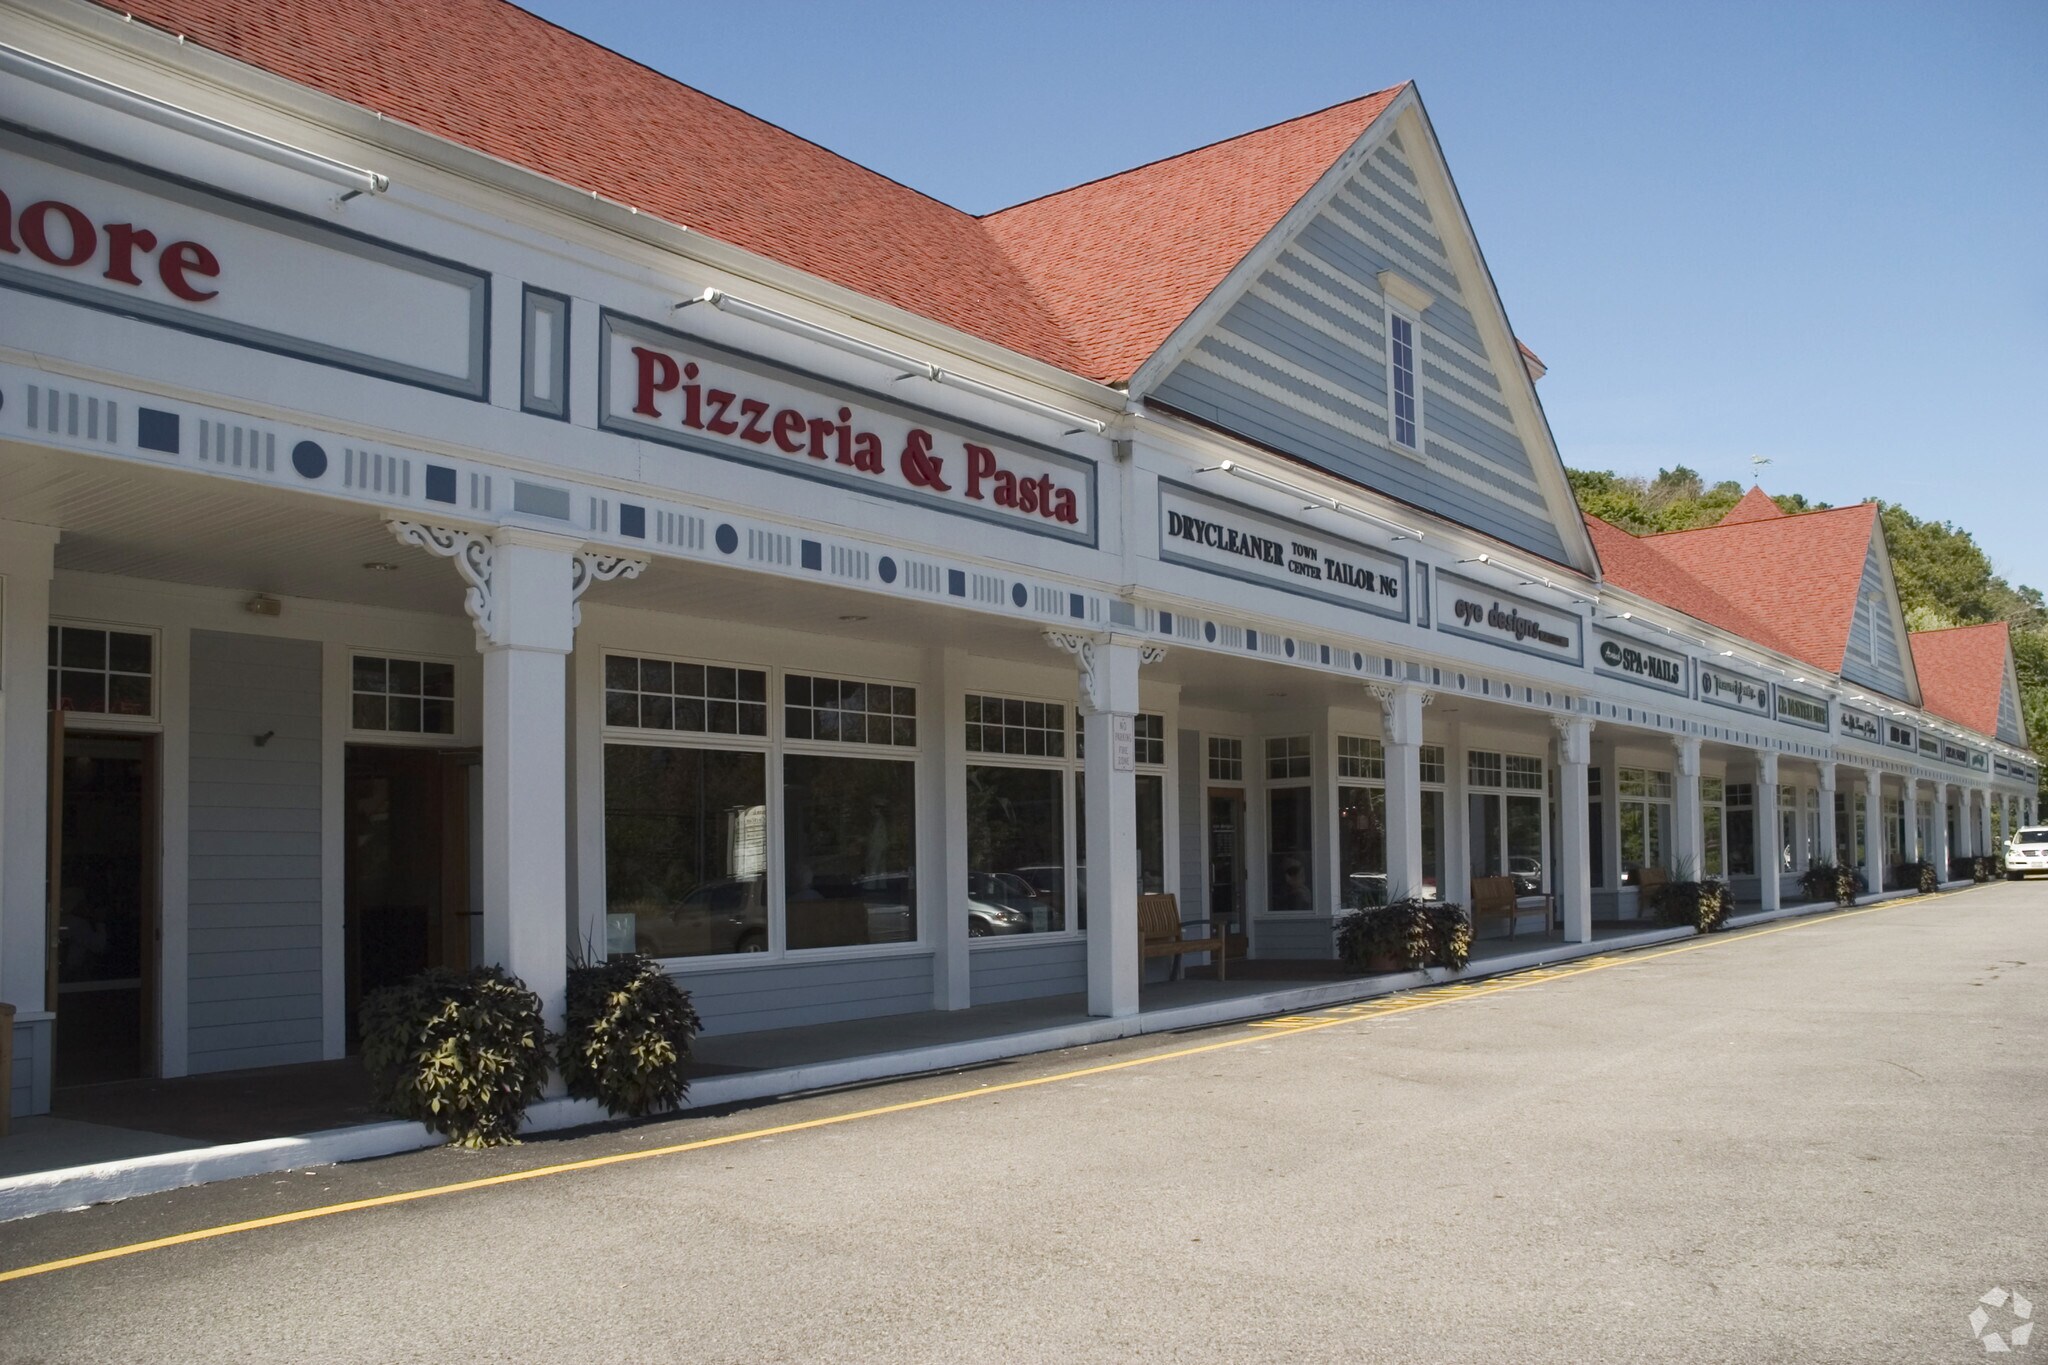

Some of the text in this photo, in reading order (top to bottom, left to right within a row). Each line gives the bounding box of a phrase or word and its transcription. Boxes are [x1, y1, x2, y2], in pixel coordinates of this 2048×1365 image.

[631, 346, 1079, 524] Pizzeria & Pasta
[1168, 510, 1284, 566] DRYCLEANER
[1291, 542, 1317, 560] TOWN
[1288, 559, 1321, 580] CENTER
[1455, 599, 1483, 626] eye
[1488, 602, 1540, 641] designs
